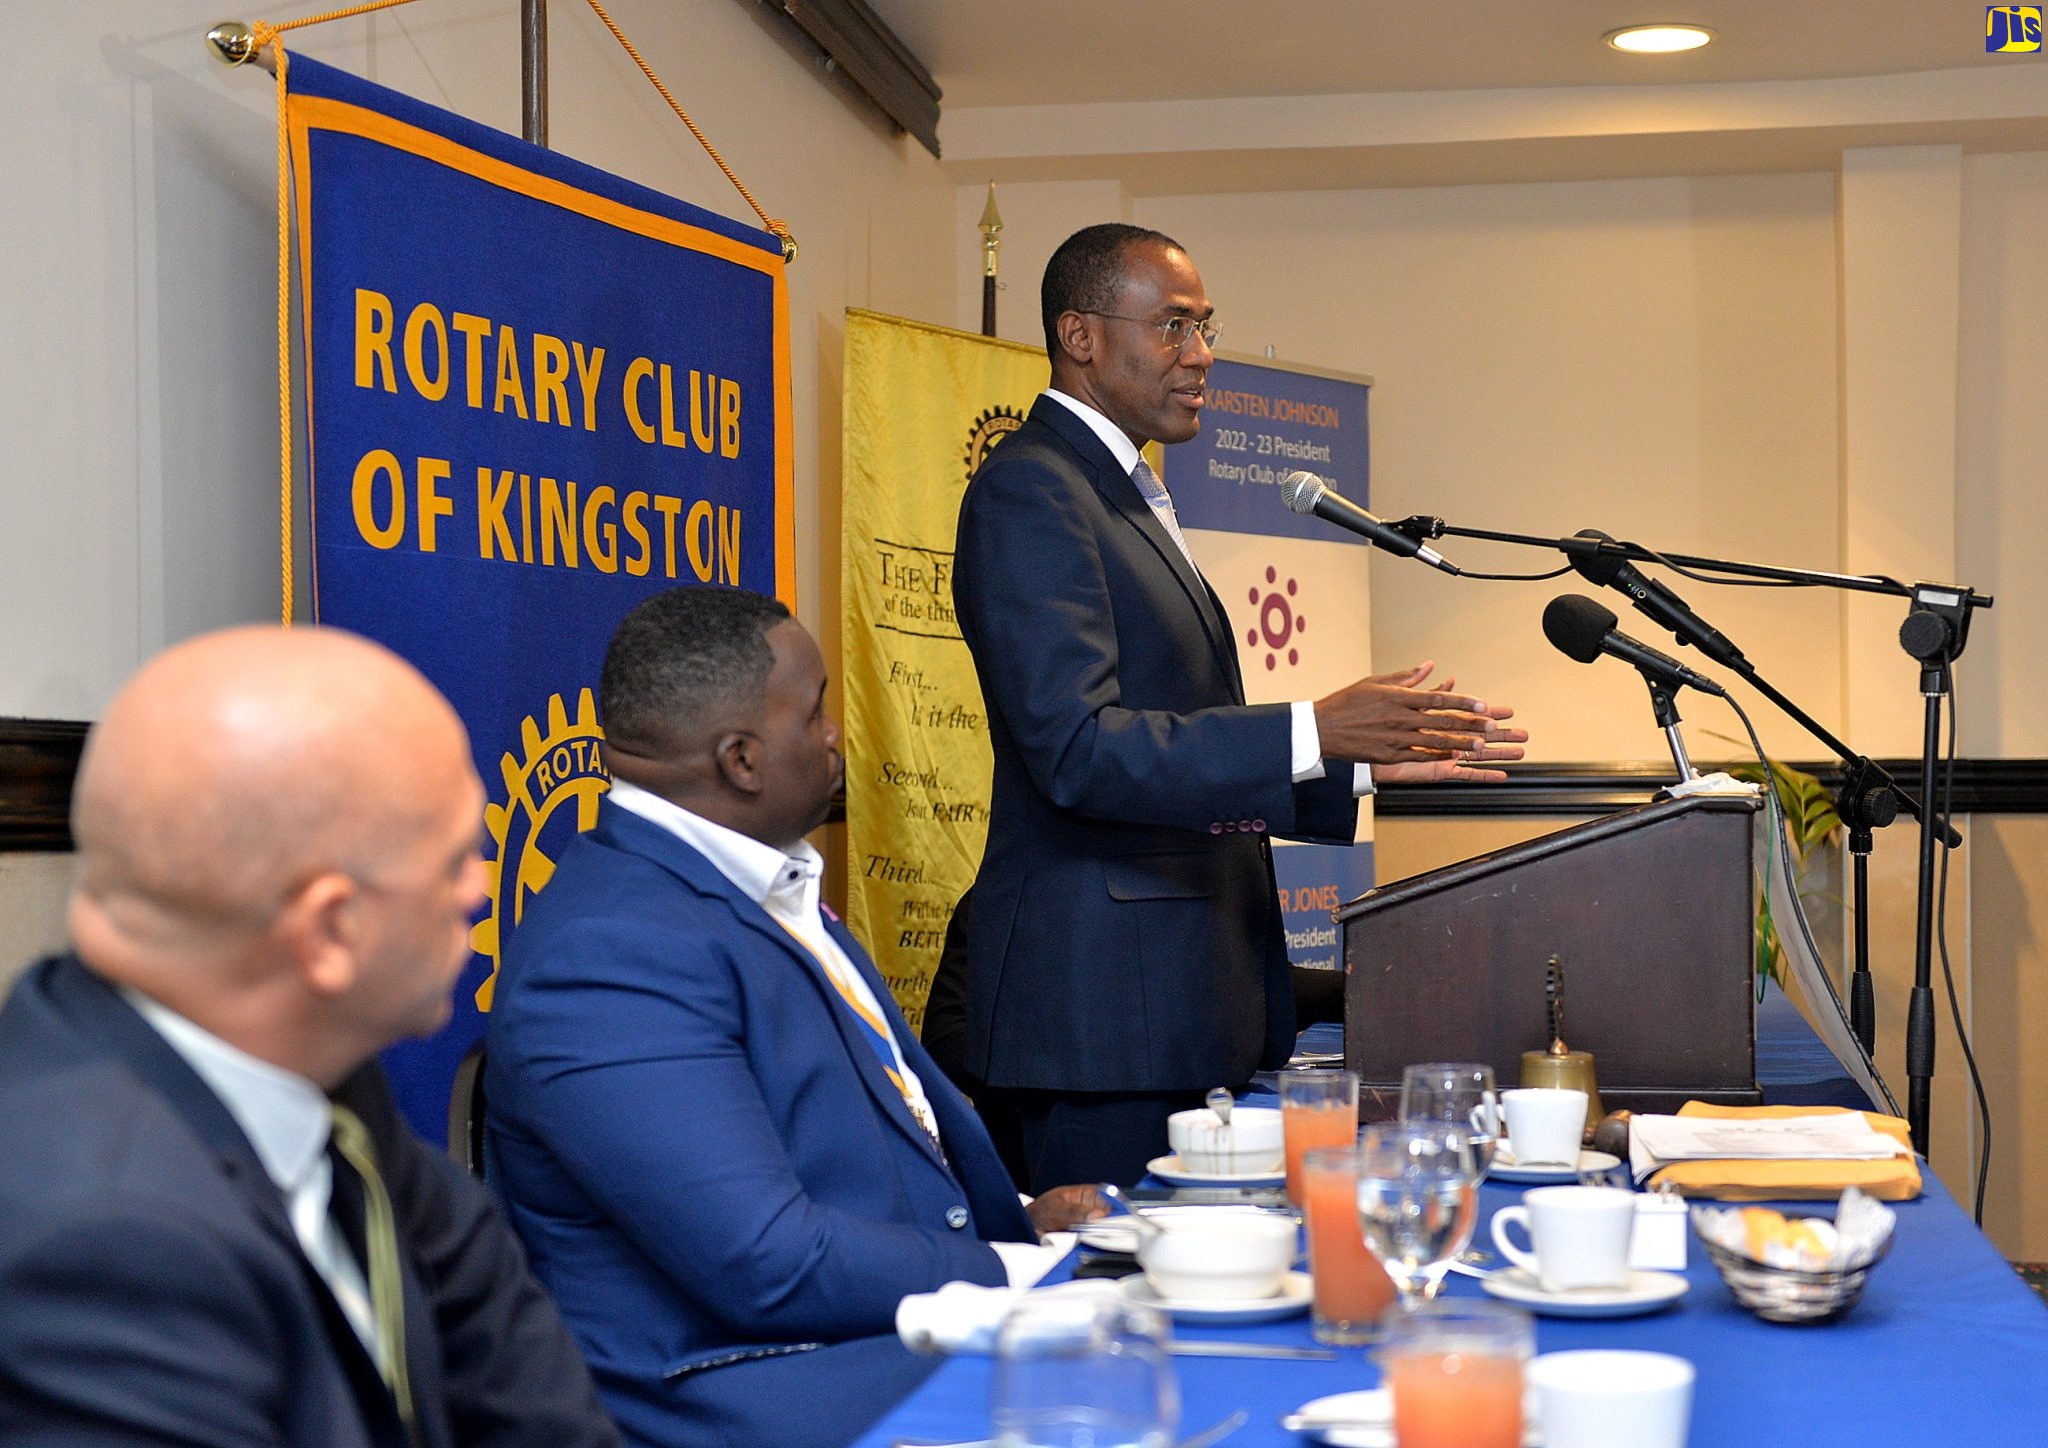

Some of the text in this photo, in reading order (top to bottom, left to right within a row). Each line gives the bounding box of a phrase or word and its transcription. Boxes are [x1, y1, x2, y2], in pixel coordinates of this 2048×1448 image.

[355, 288, 741, 460] ROTARY CLUB
[1205, 388, 1339, 429] KARSTEN JOHNSON
[1216, 429, 1247, 451] 2022
[1257, 434, 1272, 455] 23
[1274, 437, 1331, 463] President
[1208, 459, 1247, 486] Rotary
[1248, 464, 1275, 485] Club
[352, 449, 741, 586] OF KINGSTON
[877, 550, 921, 592] THE
[885, 594, 898, 614] of
[900, 597, 921, 618] the
[928, 705, 942, 728] it
[948, 705, 978, 729] the
[536, 740, 609, 797] ROTA
[932, 802, 974, 822] FAIR
[1294, 885, 1339, 912] JONES
